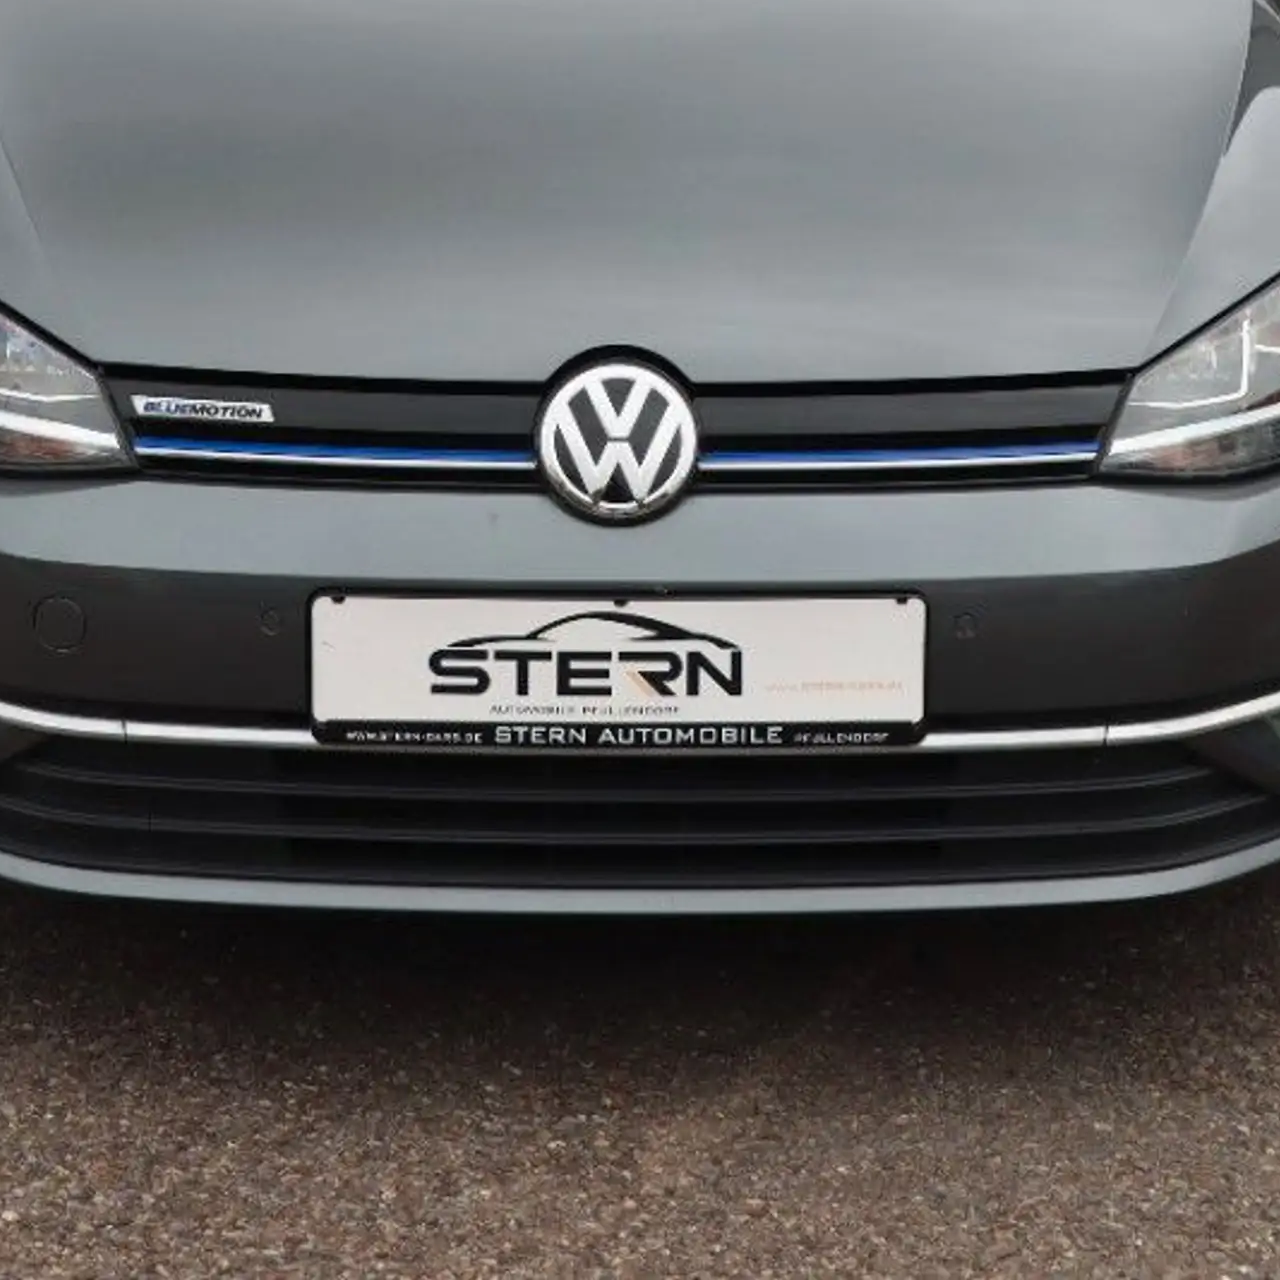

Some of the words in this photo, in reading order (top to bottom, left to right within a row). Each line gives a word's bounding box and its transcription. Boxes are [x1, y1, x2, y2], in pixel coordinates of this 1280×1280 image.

[143, 401, 263, 419] BLUEMOTION
[550, 372, 687, 512] VW
[429, 648, 742, 696] STERN
[495, 726, 586, 745] STERN
[598, 726, 783, 746] AUTOMOBILE
